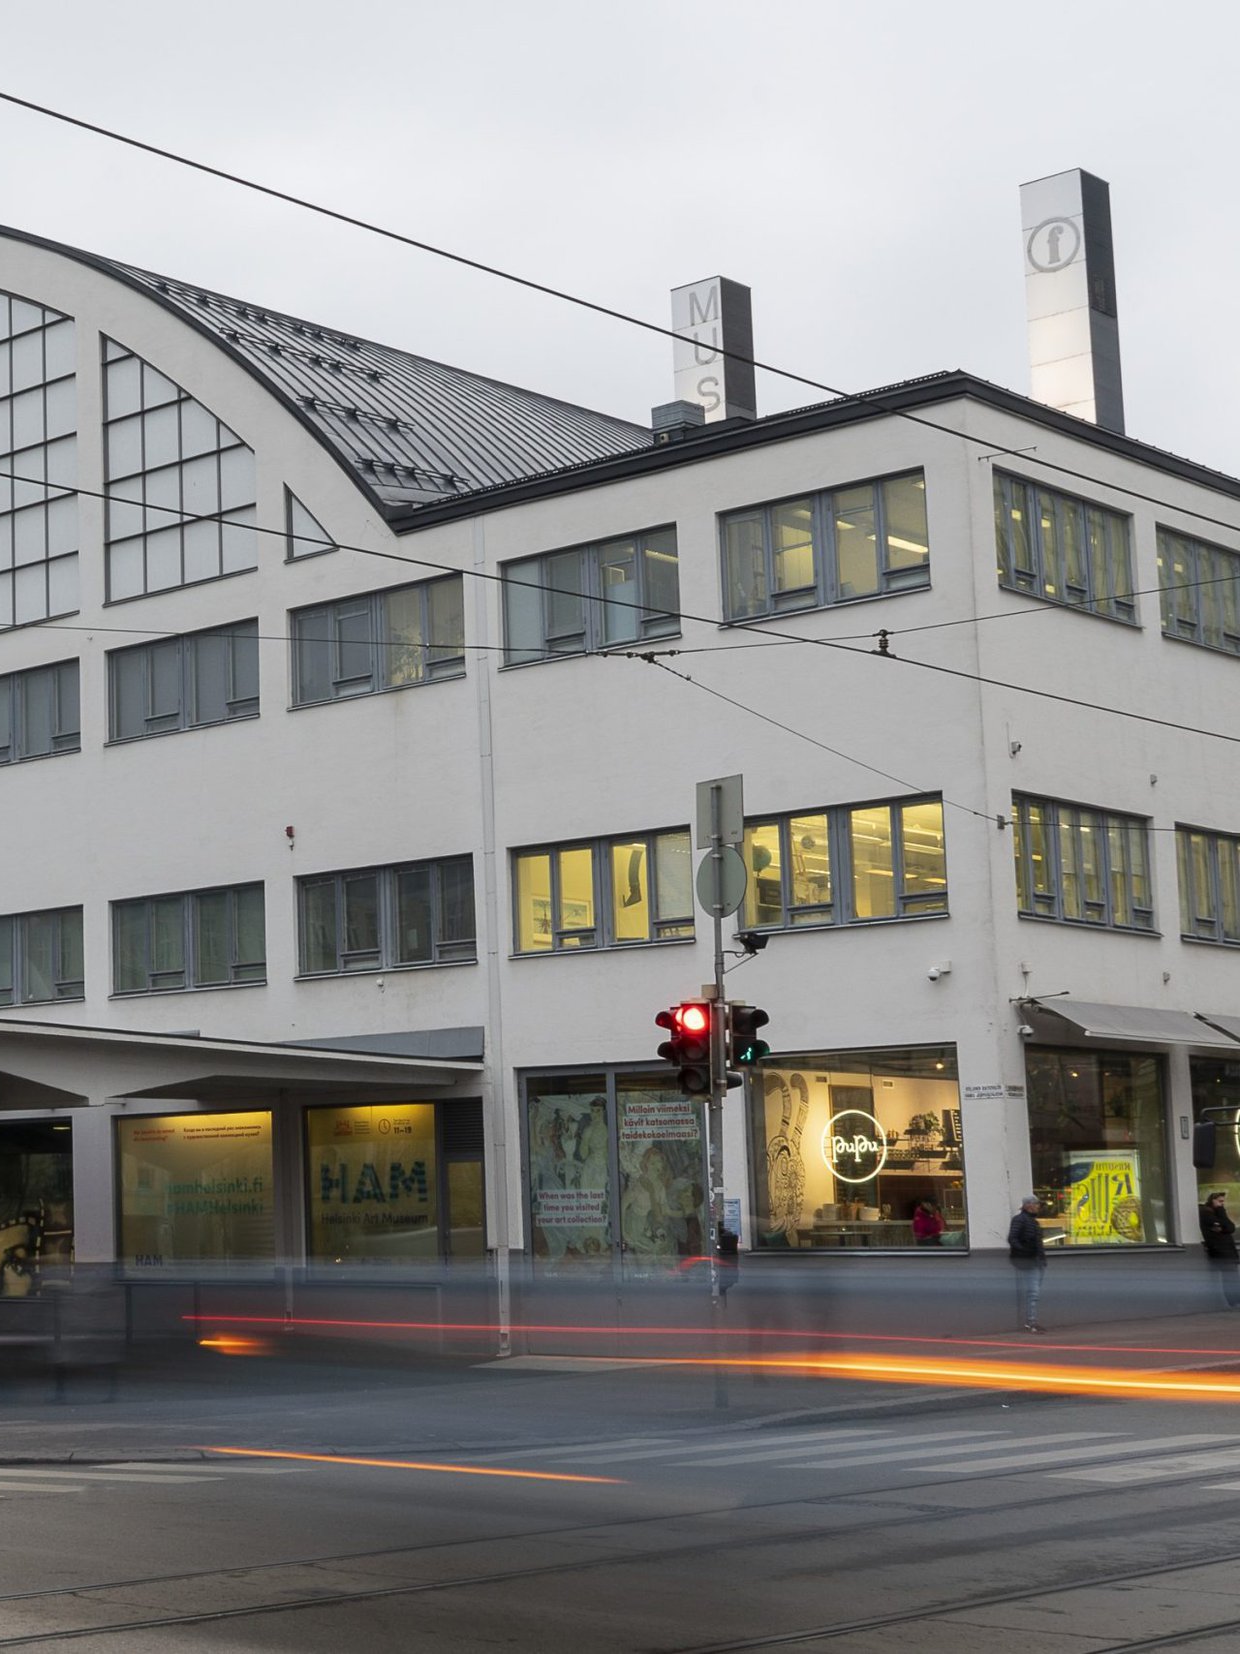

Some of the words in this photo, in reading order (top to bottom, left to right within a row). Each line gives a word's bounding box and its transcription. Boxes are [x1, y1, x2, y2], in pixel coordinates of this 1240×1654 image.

[688, 285, 721, 413] MUS
[627, 1105, 656, 1114] Milloin
[656, 1104, 691, 1113] viimeksi
[645, 1117, 695, 1126] katsomassa
[831, 1134, 880, 1163] pupu
[321, 1161, 428, 1204] HAM
[538, 1191, 559, 1200] When
[576, 1191, 589, 1199] the
[590, 1191, 604, 1199] last
[543, 1203, 559, 1211] time
[561, 1204, 574, 1213] you
[575, 1203, 600, 1211] visited
[321, 1212, 360, 1225] Helsinki
[363, 1212, 379, 1225] Art
[382, 1212, 428, 1225] Museum
[537, 1217, 554, 1225] your
[567, 1215, 607, 1223] collection?
[135, 1254, 163, 1267] HAM
